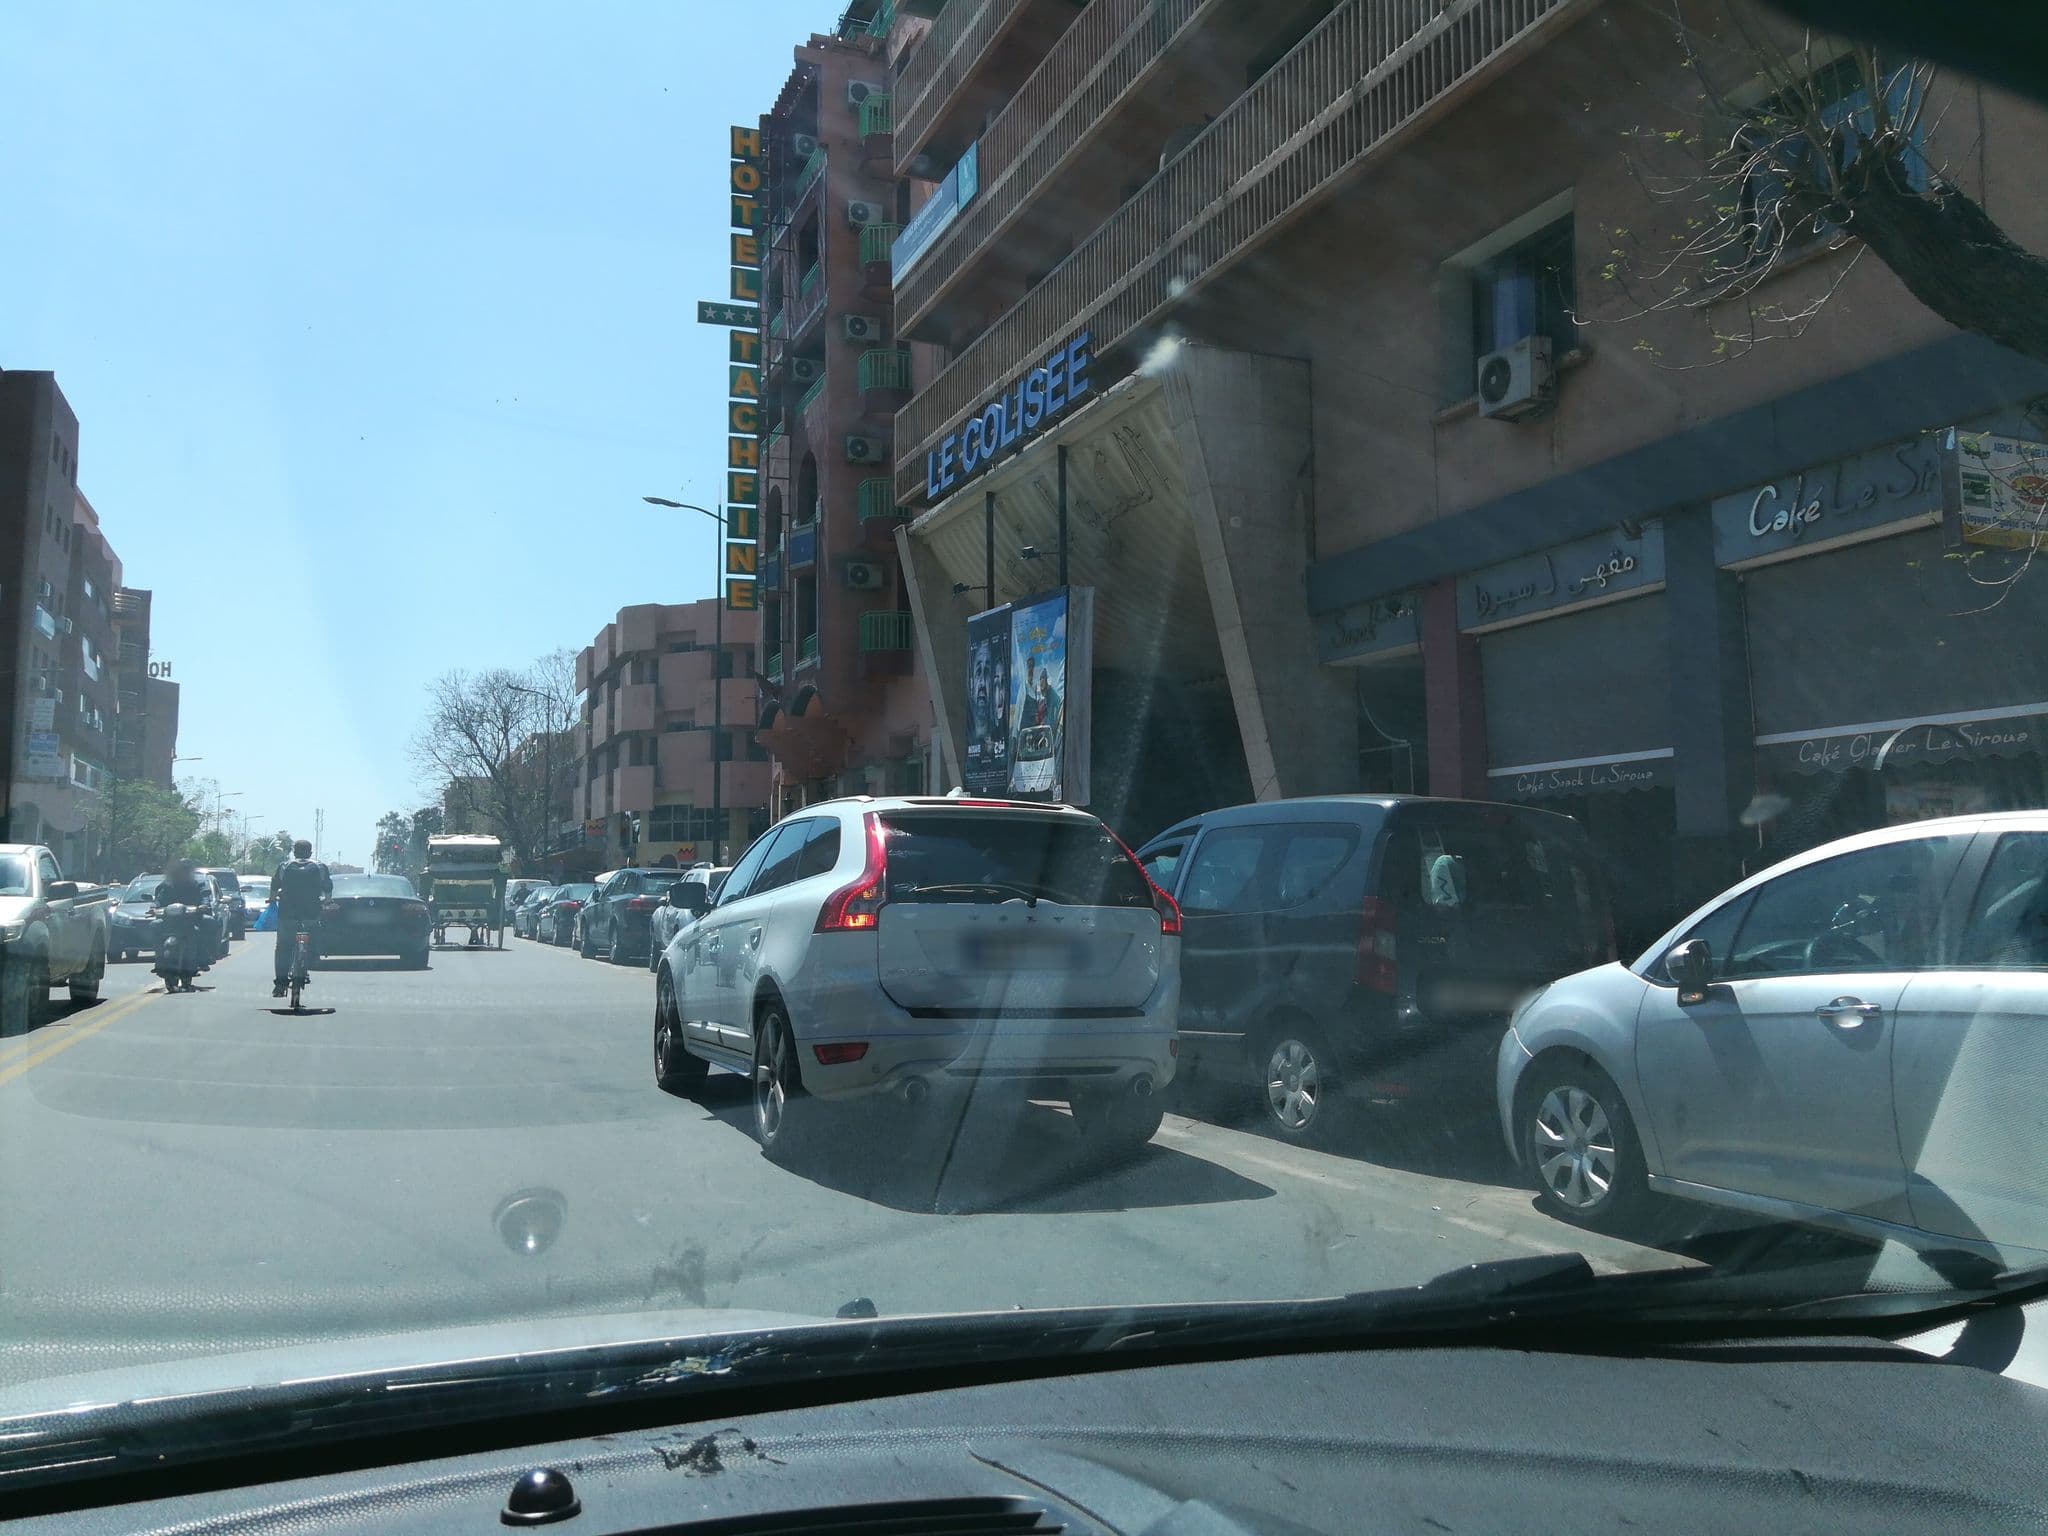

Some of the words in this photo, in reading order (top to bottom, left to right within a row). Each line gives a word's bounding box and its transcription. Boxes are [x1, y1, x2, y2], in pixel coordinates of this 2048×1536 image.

[734, 128, 761, 300] HOTEL
[730, 332, 759, 609] TACHFINE
[927, 433, 956, 500] LE
[961, 331, 1089, 474] COLISEE
[1517, 774, 1544, 794] Café
[1799, 738, 1841, 768] Café
[1850, 734, 1917, 762] Glaier
[1926, 727, 1953, 751] Le
[1954, 723, 2030, 750] Siroua
